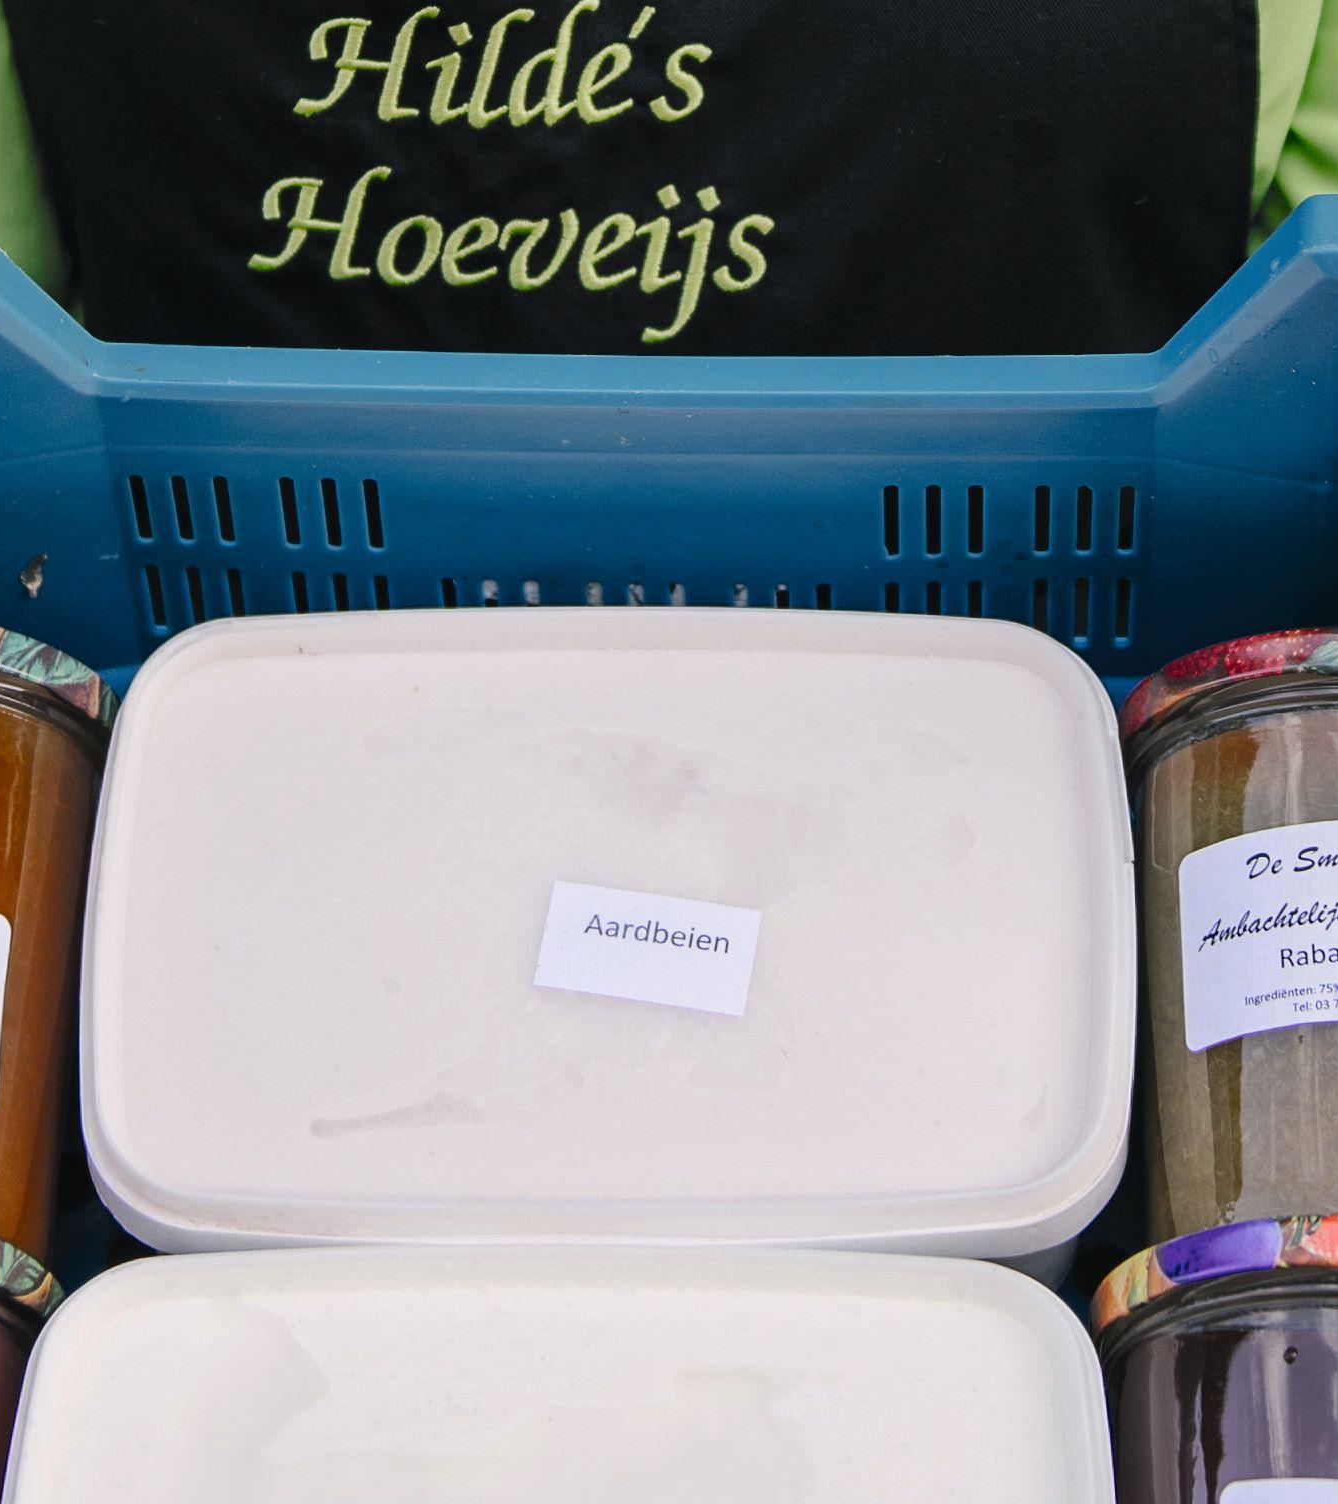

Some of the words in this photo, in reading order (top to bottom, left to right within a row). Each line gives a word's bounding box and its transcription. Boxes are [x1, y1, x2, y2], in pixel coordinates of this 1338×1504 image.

[1246, 852, 1283, 880] De
[584, 913, 730, 954] Aardbeien
[1292, 1001, 1313, 1012] Tel:
[1315, 999, 1330, 1010] 03
